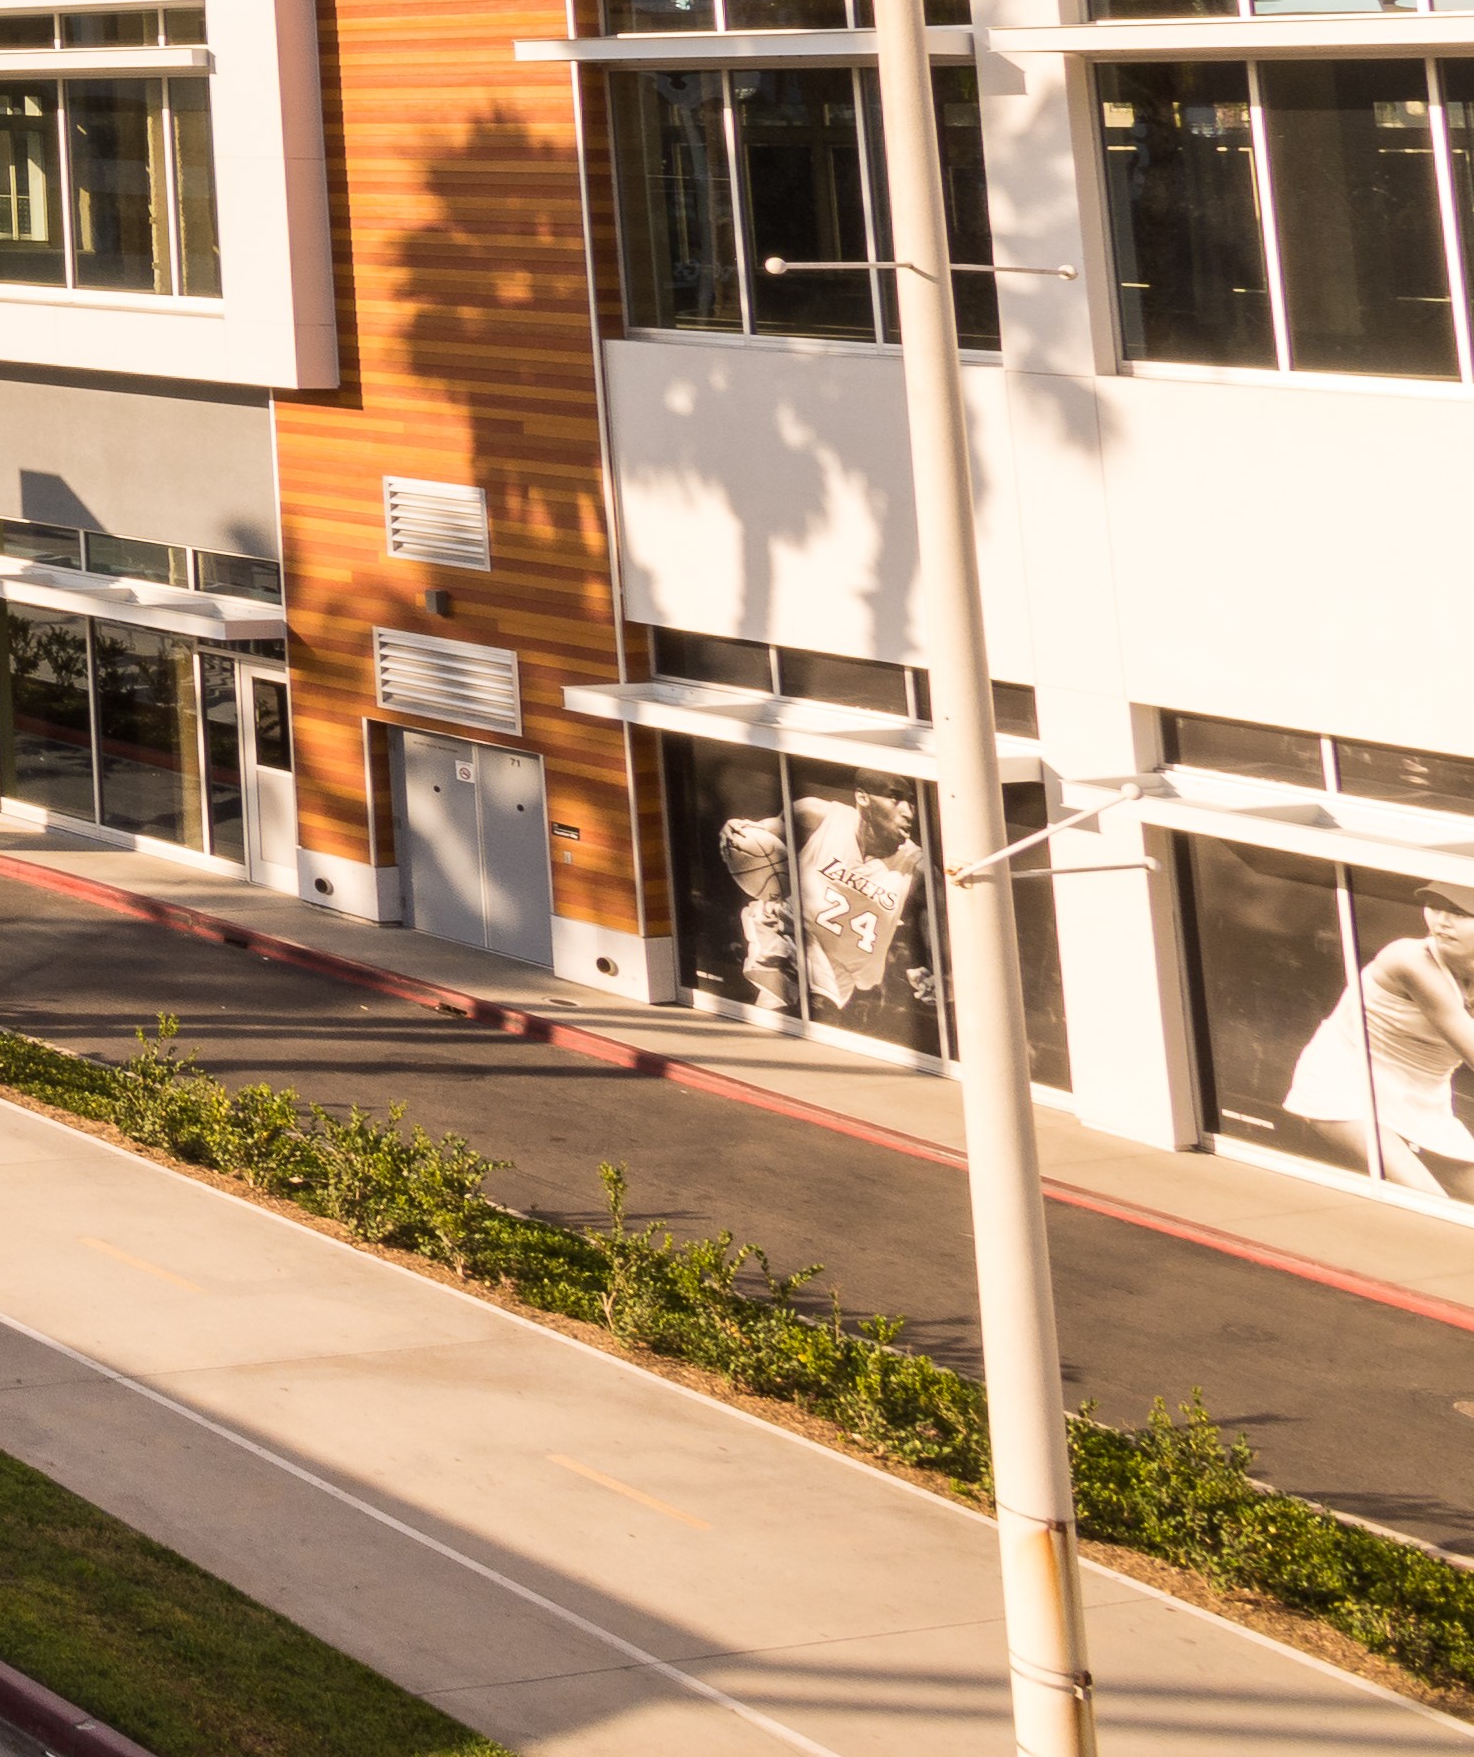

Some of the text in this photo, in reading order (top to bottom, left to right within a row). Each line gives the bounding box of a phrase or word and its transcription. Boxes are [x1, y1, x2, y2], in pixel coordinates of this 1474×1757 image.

[510, 758, 521, 767] 71
[817, 857, 897, 911] LAKERS
[815, 887, 878, 954] 24
